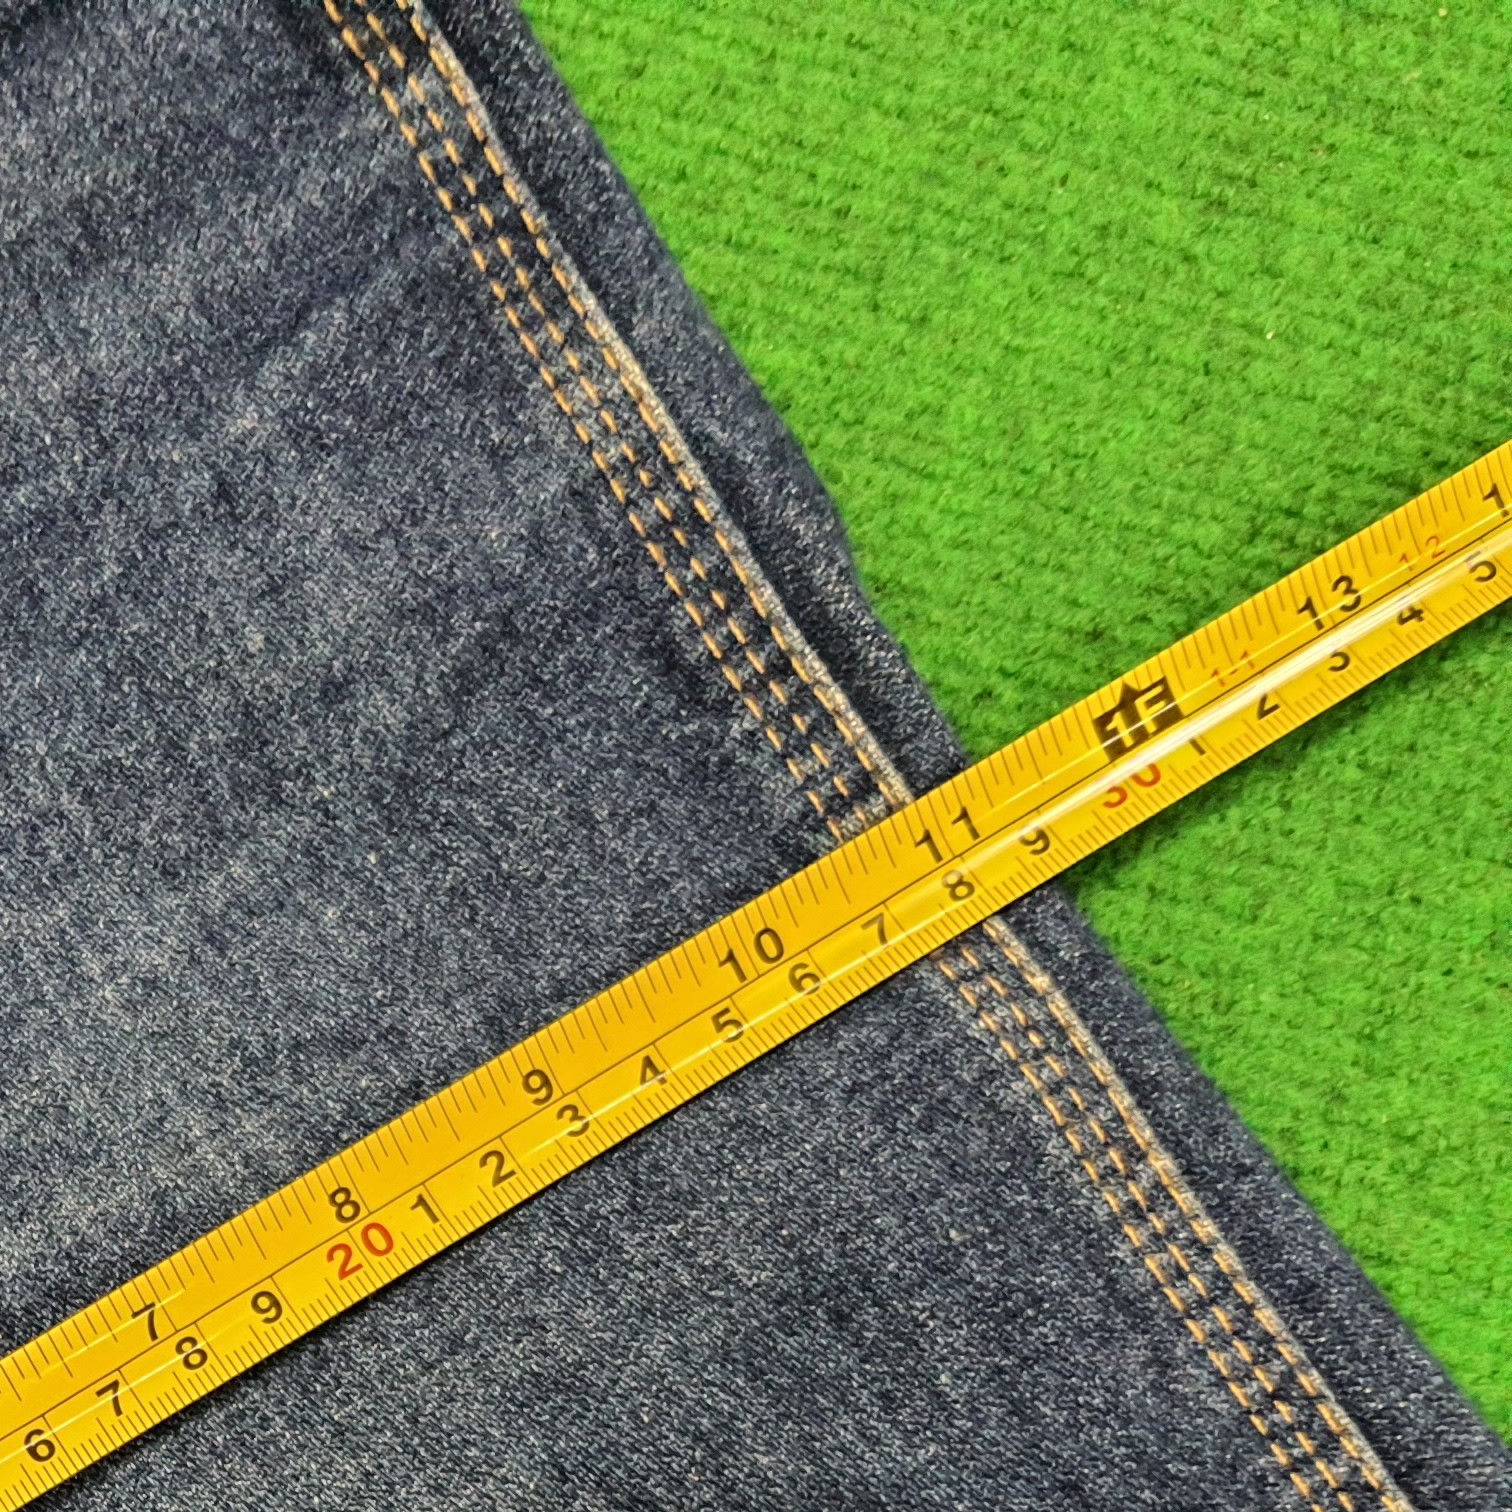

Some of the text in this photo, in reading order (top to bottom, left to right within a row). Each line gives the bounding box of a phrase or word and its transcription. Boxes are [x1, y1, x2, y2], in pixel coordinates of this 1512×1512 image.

[23, 1427, 57, 1463] 6
[95, 1380, 125, 1418] 7
[174, 1335, 209, 1372] 8
[251, 1289, 284, 1325] 9
[326, 1221, 395, 1281] 20
[410, 1193, 440, 1226] 1
[479, 1149, 516, 1187] 2
[556, 1103, 590, 1139] 3
[638, 1054, 668, 1090] 4
[711, 1007, 746, 1044] 5
[787, 963, 822, 996] 6
[860, 912, 890, 947] 7
[941, 869, 976, 902] 8
[1019, 825, 1052, 857] 9
[131, 1302, 162, 1342] 7
[328, 1186, 361, 1223] 8
[522, 1068, 553, 1105] 9
[718, 927, 784, 984] 10
[914, 807, 981, 862] 11
[1296, 575, 1362, 631] 13
